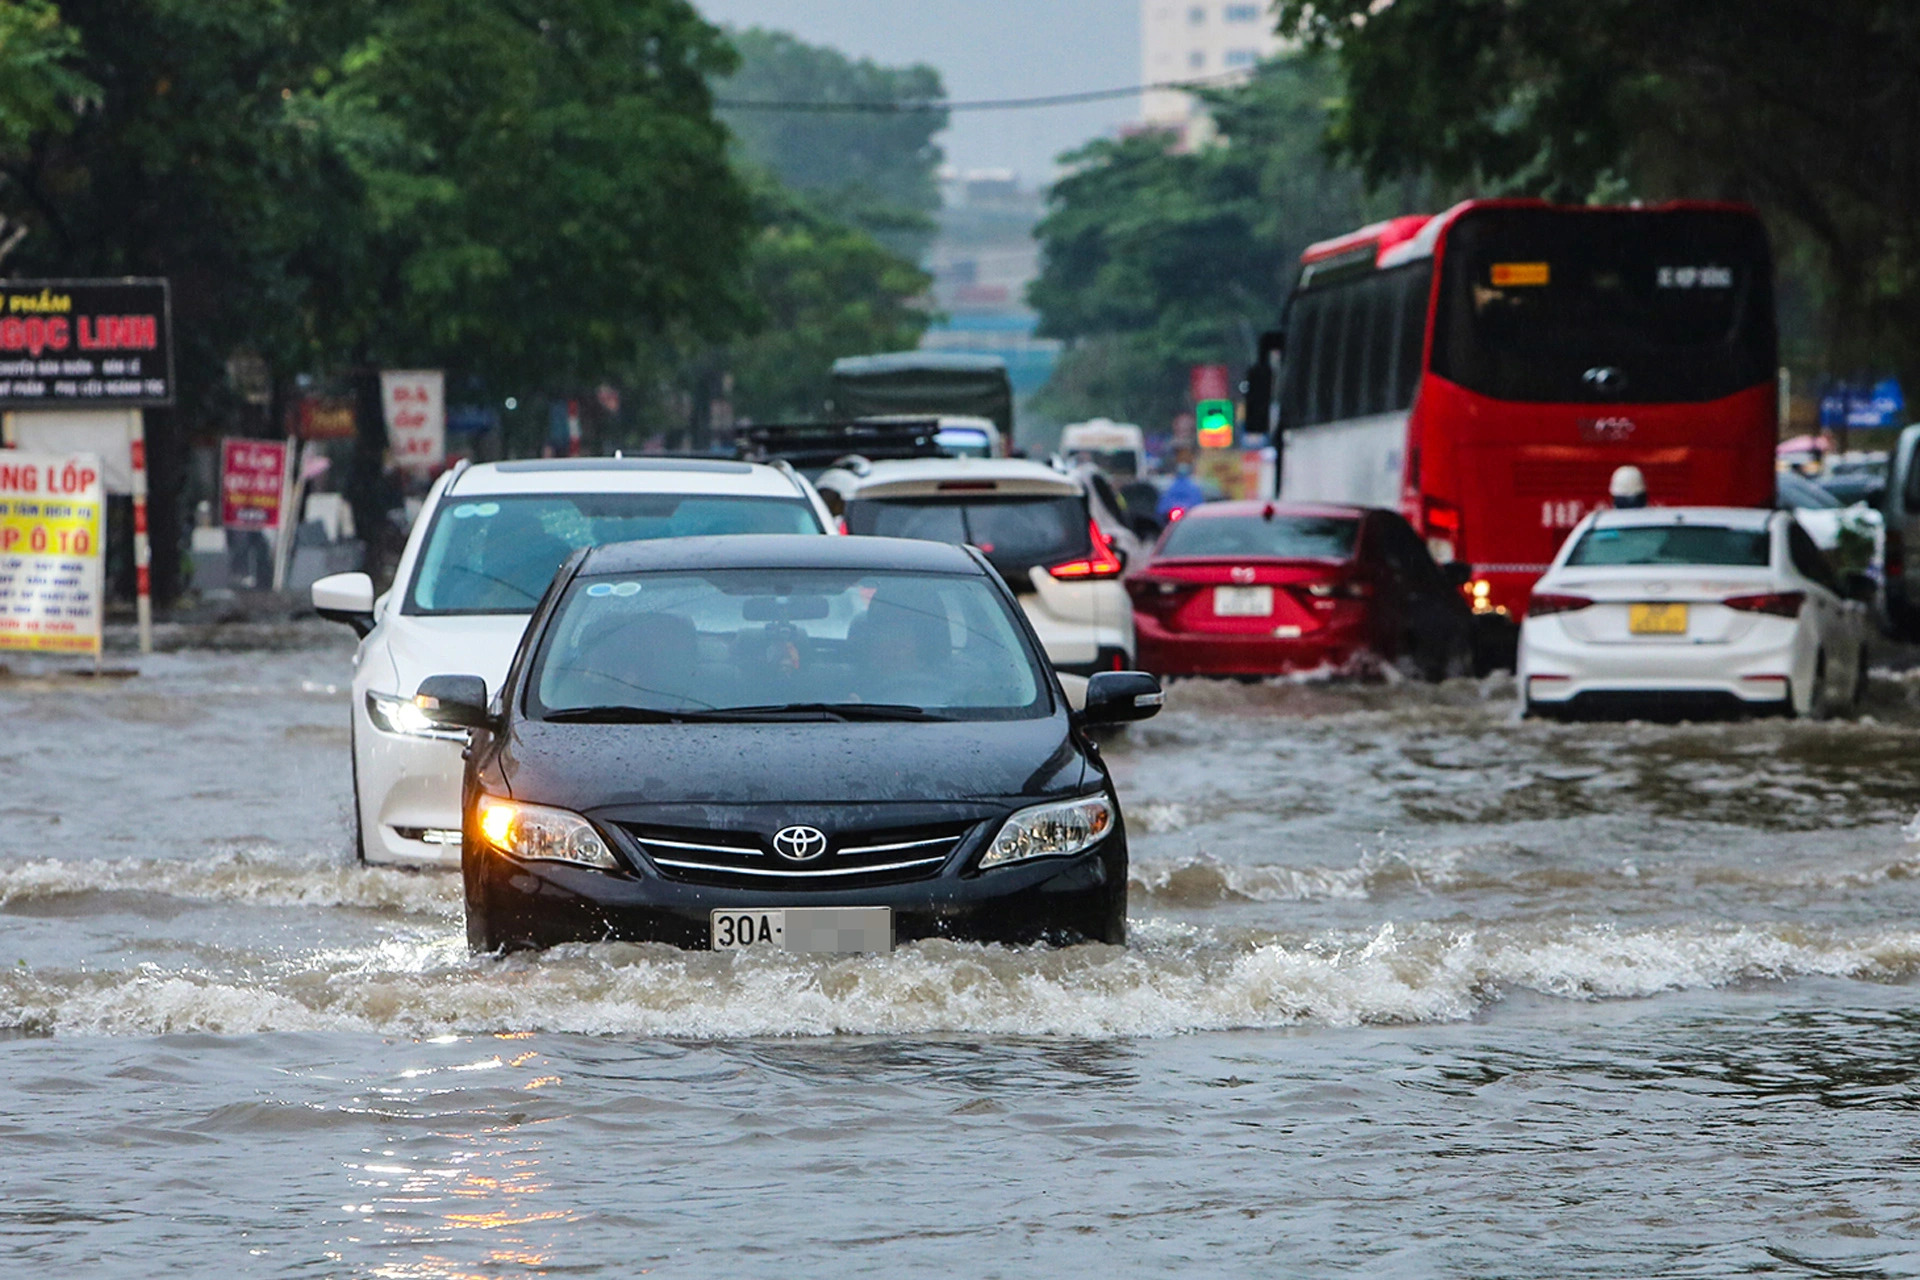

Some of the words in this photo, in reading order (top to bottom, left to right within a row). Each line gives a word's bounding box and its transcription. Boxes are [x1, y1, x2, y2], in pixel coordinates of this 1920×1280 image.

[9, 287, 72, 313] PHẨM
[0, 316, 70, 357] GỌC
[77, 315, 157, 350] LINH
[47, 456, 96, 494] LỐP
[31, 525, 46, 552] Ô
[60, 529, 90, 554] TÔ
